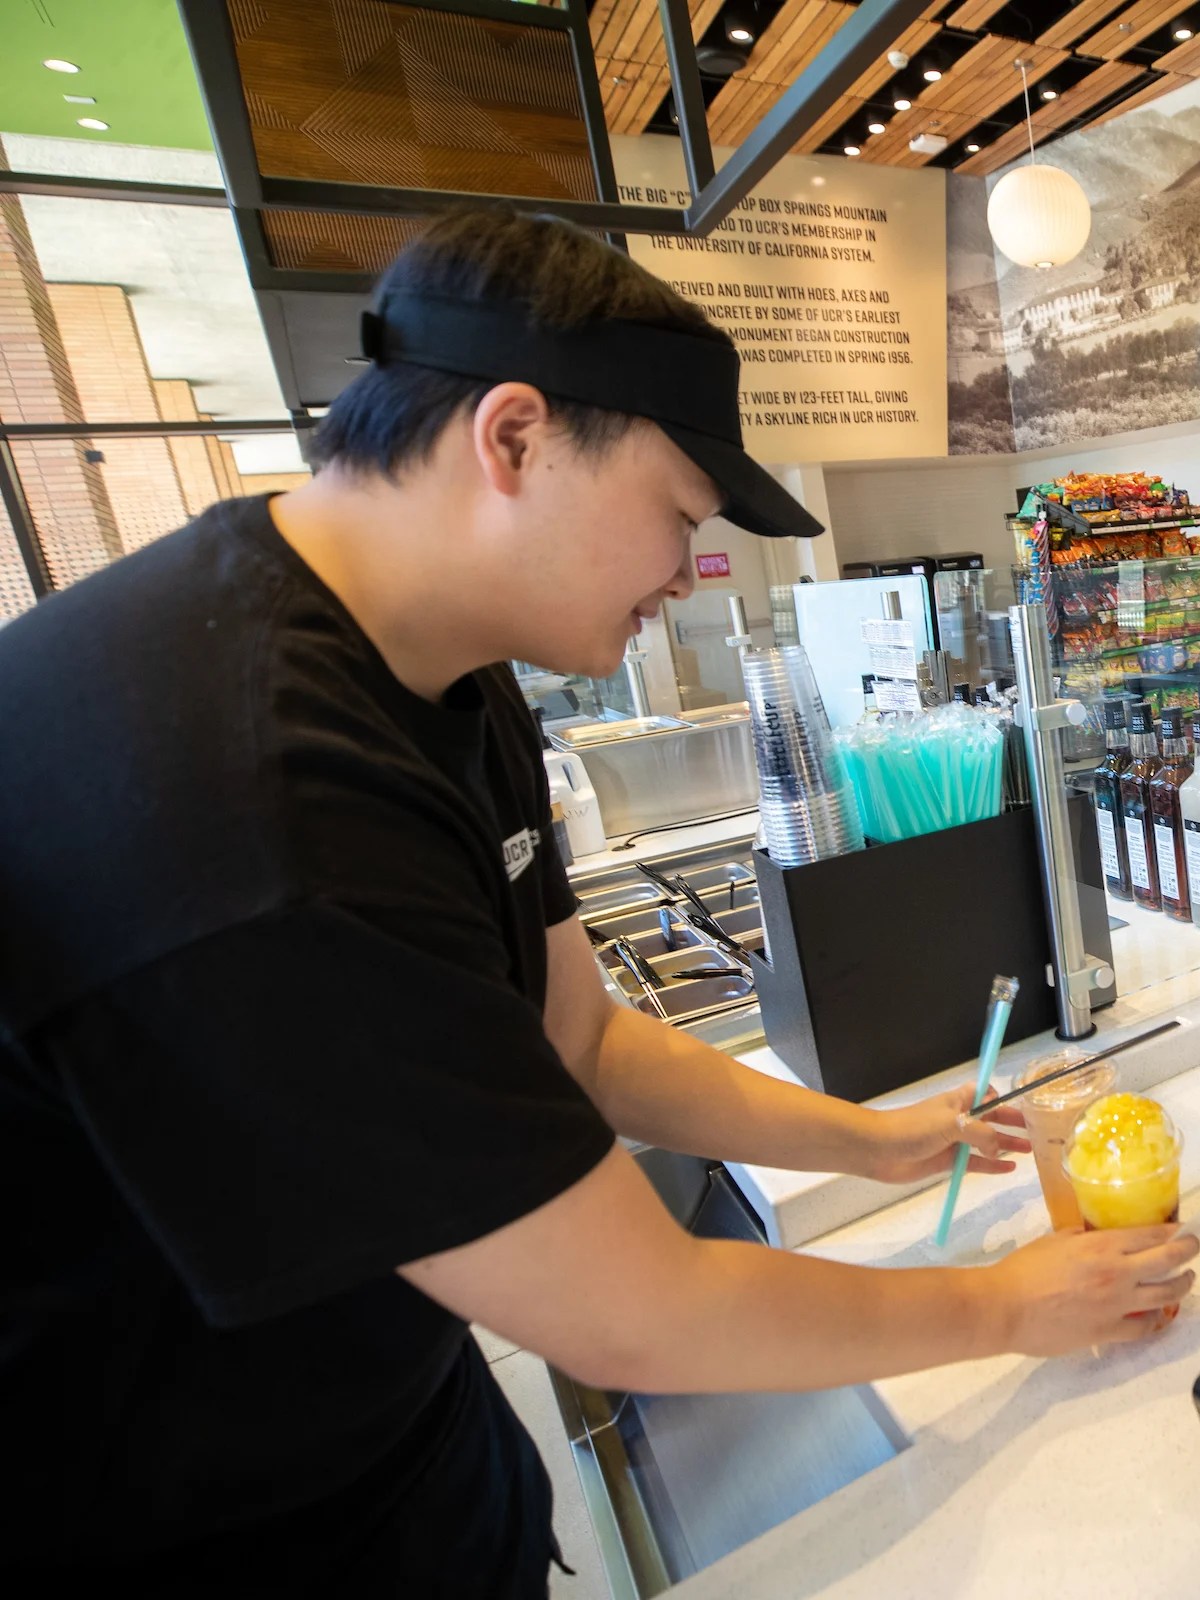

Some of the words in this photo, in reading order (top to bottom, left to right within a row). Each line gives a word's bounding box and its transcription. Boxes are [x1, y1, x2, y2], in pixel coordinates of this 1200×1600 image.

[619, 186, 641, 201] THE
[646, 188, 667, 203] BIG
[759, 199, 781, 213] BOX
[784, 201, 831, 218] SPRINGS
[834, 206, 888, 223] MOUNTAIN
[738, 219, 753, 233] TO
[756, 220, 789, 235] UCR'S
[792, 223, 863, 241] MEMBERSHIP
[865, 229, 876, 242] IN
[650, 234, 675, 249] THE
[676, 235, 745, 255] UNIVERSITY
[749, 241, 762, 255] OF
[764, 242, 829, 259] CALIFORNIA
[831, 247, 875, 263] SYSTEM.
[718, 282, 741, 297] AND
[743, 284, 774, 299] BUILT
[776, 286, 805, 300] WITH
[807, 287, 839, 303] HOES,
[841, 289, 867, 303] AXES
[869, 290, 890, 303] AND
[755, 306, 769, 320] BY
[772, 307, 803, 321] SOME
[805, 308, 818, 321] OF
[821, 308, 853, 322] UCR'S
[855, 310, 900, 324] EARLIEST
[728, 327, 793, 341] MONUMENT
[795, 328, 831, 342] BEGAN
[833, 329, 910, 344] CONSTRUCTION
[740, 348, 766, 362] WAS
[768, 349, 832, 363] COMPLETED
[835, 350, 846, 363] IN
[848, 350, 885, 364] SPRING
[888, 351, 913, 364] 1956.
[751, 391, 780, 405] WIDE
[783, 391, 796, 404] BY
[799, 390, 844, 404] 123-FEET
[844, 390, 873, 404] TALL,
[875, 390, 908, 403] GIVING
[755, 412, 763, 426] A
[765, 411, 810, 426] SKYLINE
[813, 411, 837, 424] RICH
[840, 411, 851, 423] IN
[853, 410, 874, 423] UCR
[876, 410, 919, 423] HISTORY.
